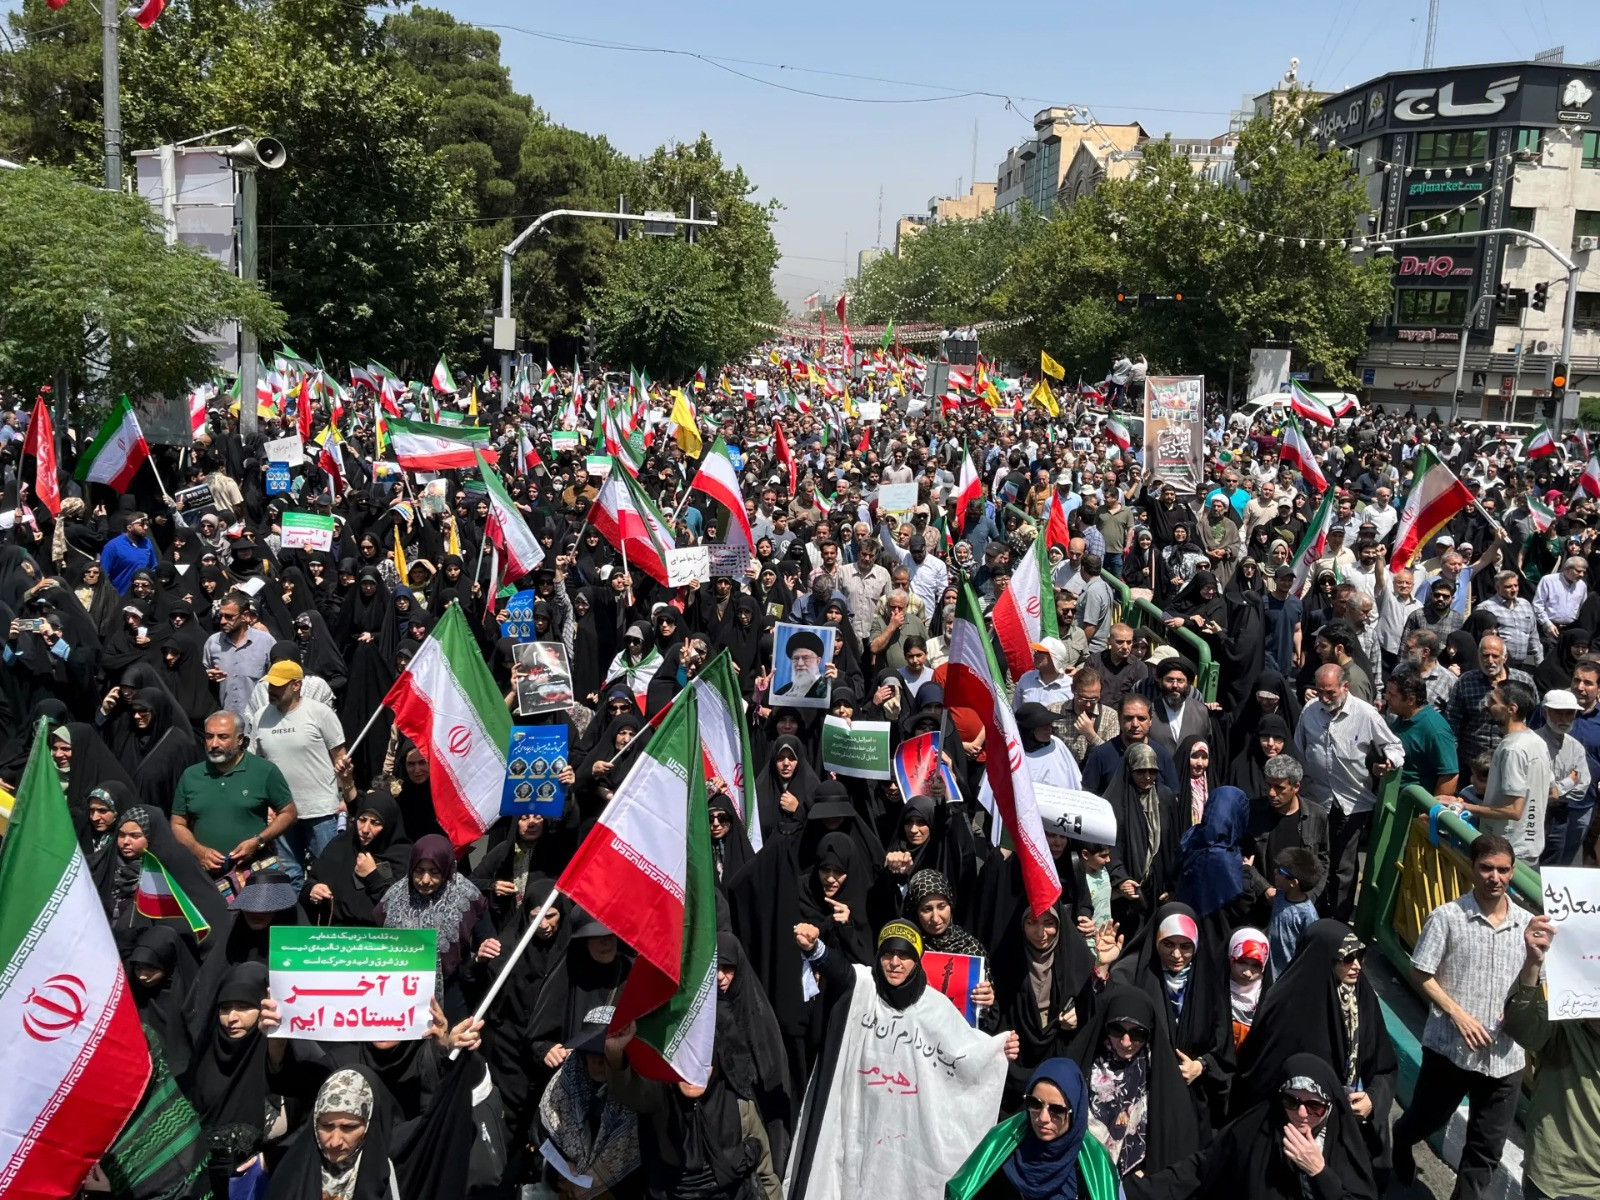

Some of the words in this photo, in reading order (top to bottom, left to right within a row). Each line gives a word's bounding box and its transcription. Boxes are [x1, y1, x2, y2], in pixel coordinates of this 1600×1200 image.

[1393, 75, 1521, 121] گاج
[1395, 136, 1403, 157] GAJ
[1499, 130, 1507, 152] GAJ
[1408, 181, 1484, 195] gajmarket.com
[1489, 157, 1504, 244] INTENATIONL
[1399, 256, 1474, 278] DriQ.com
[1478, 250, 1493, 328] PUBLICAIONS
[1398, 328, 1459, 342] mygaj.com
[338, 932, 367, 941] نزدیک
[389, 945, 404, 953] روز
[403, 944, 425, 953] امروز
[303, 956, 321, 966] است
[321, 956, 346, 967] حرکت
[351, 958, 369, 966] امید
[376, 959, 394, 967] شوق
[393, 957, 409, 966] روز
[283, 975, 391, 1003] آخر
[402, 975, 420, 996] تا
[290, 1006, 325, 1032] ایم
[333, 1006, 416, 1032] ایستاده
[875, 1015, 904, 1039] آن
[893, 1027, 923, 1054] دارم
[857, 1065, 919, 1095] رهبرم
